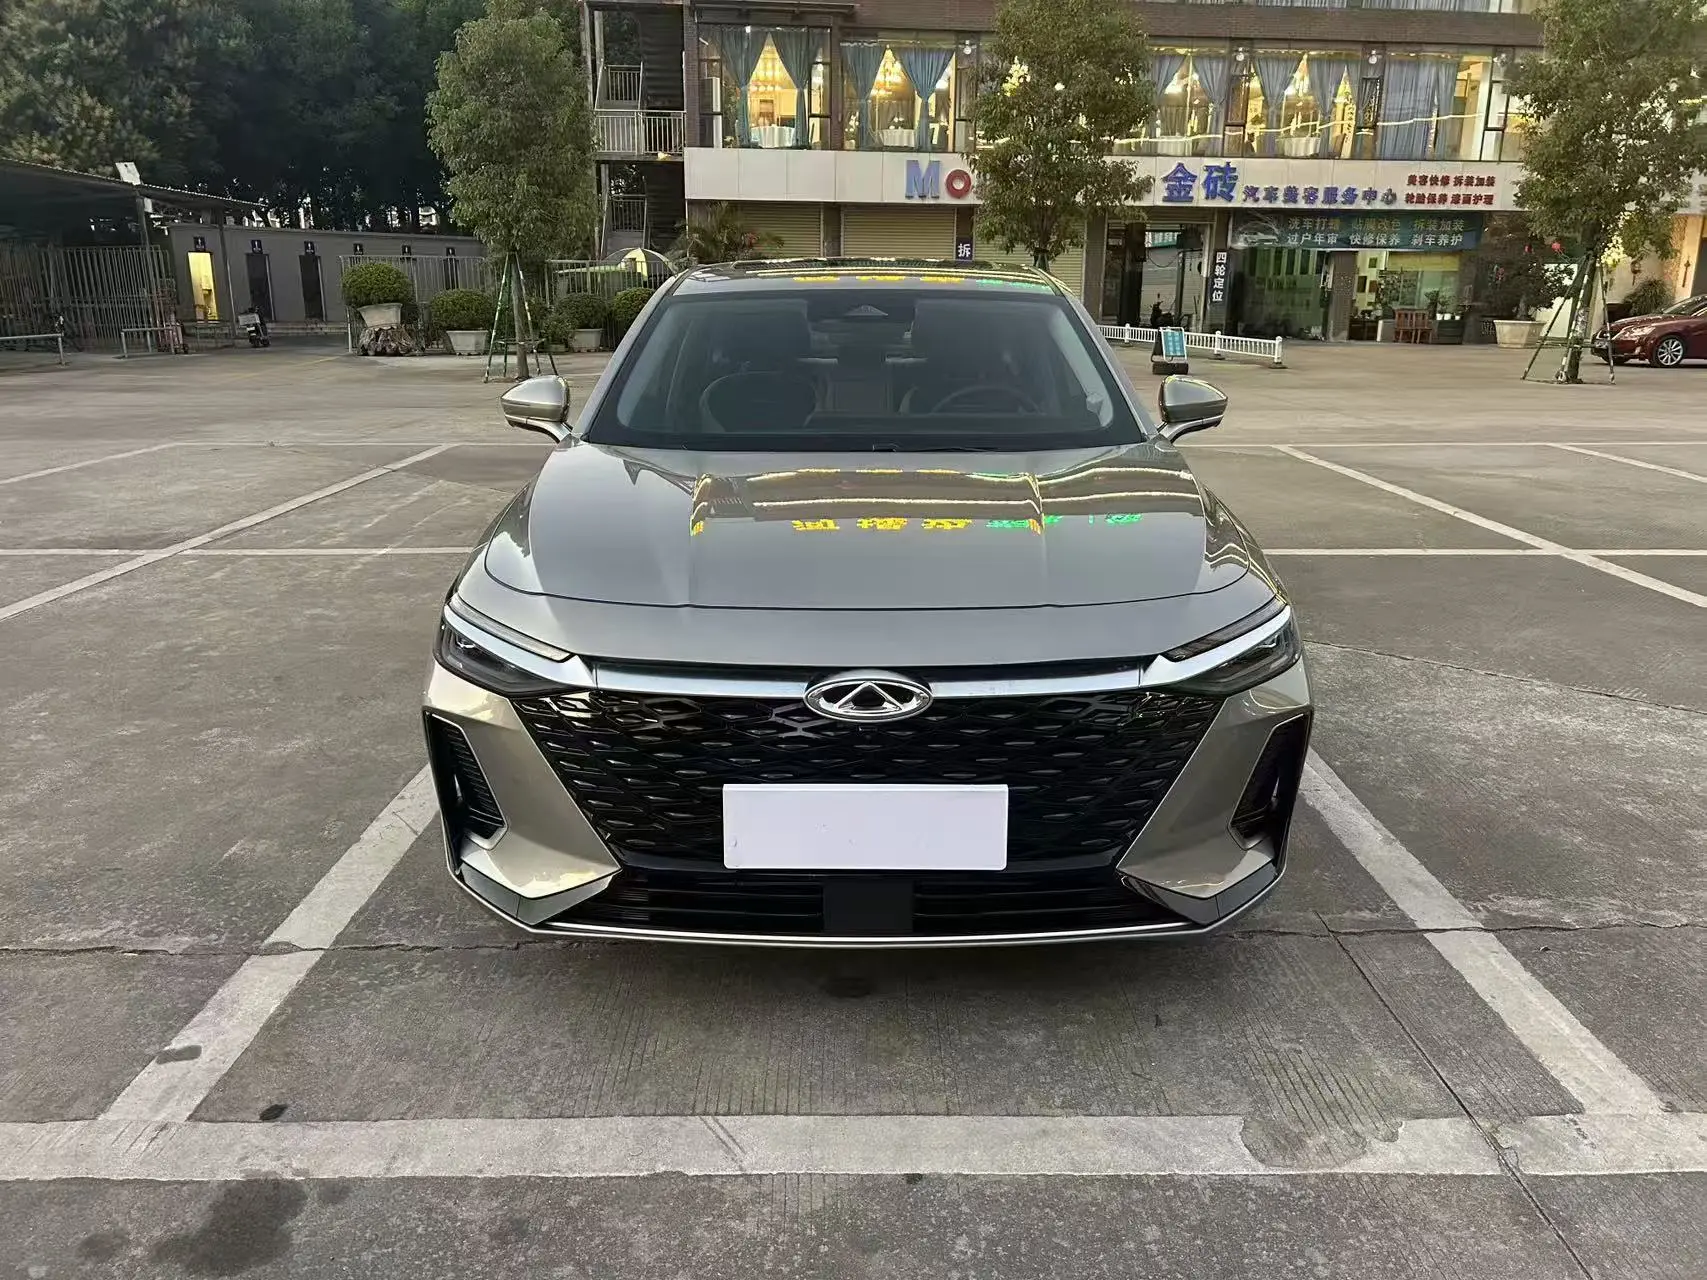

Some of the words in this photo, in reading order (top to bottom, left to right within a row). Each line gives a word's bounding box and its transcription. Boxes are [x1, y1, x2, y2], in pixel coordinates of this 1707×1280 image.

[1161, 161, 1239, 202] 金砖
[1287, 232, 1339, 245] 过户年审
[1350, 233, 1401, 246] 快修保养
[1411, 233, 1463, 246] 刹车养护
[1212, 251, 1228, 302] 四轮定位
